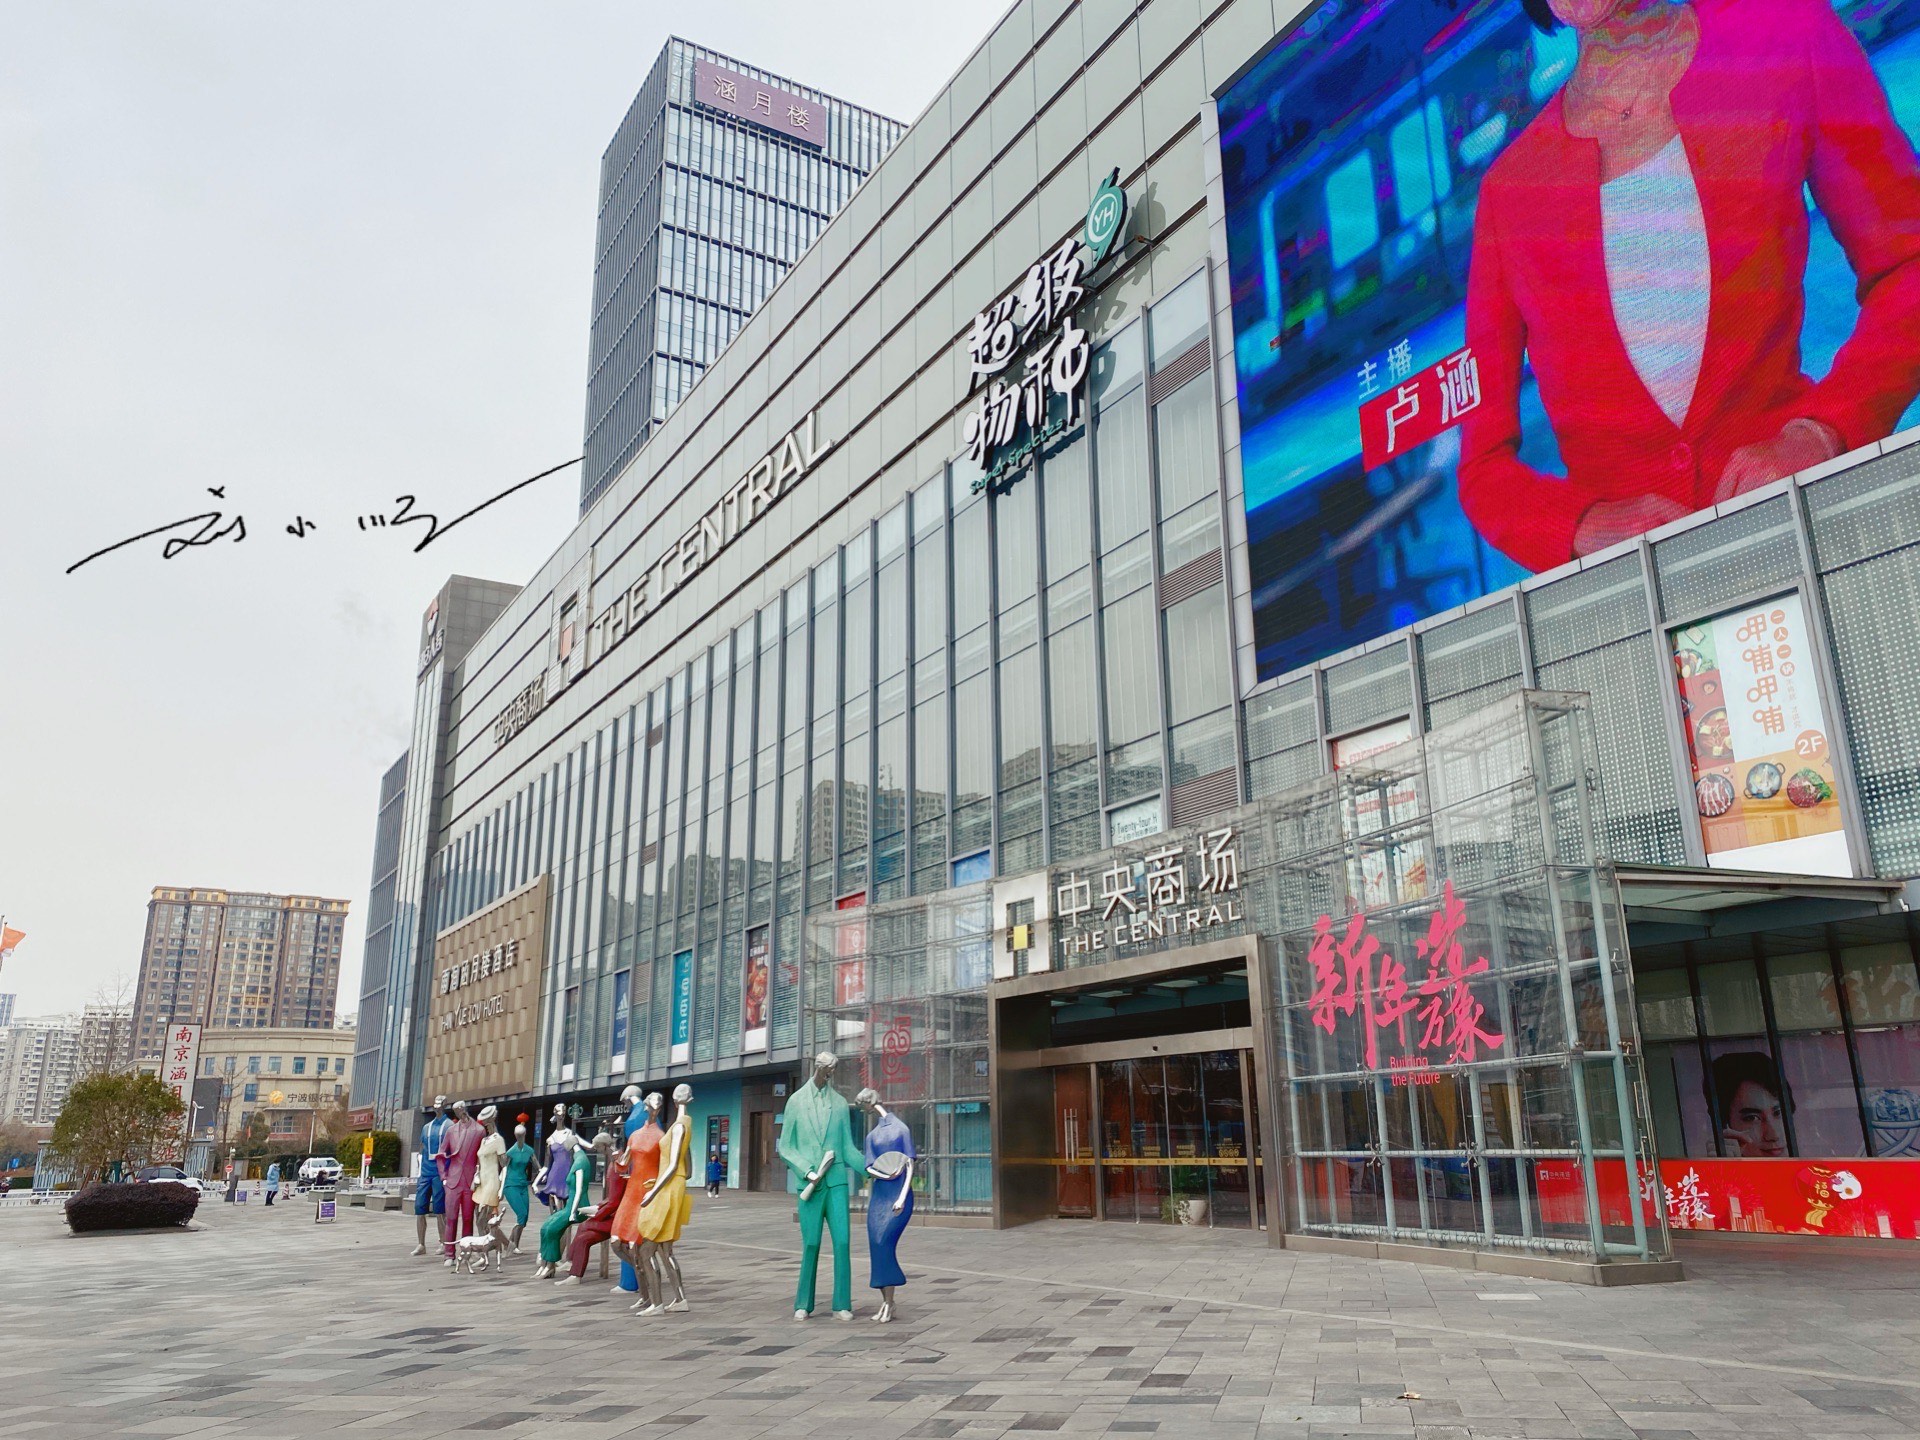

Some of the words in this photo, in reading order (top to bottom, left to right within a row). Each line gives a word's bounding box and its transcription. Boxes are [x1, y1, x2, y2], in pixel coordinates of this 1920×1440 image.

[714, 75, 810, 131] 涵月楼
[1095, 200, 1114, 234] YH
[967, 237, 1084, 397] 超级
[963, 315, 1089, 464] 物种
[1357, 338, 1412, 400] 主播
[1386, 347, 1482, 454] 卢涵
[969, 457, 1007, 494] Super
[1008, 418, 1065, 465] Species
[594, 572, 650, 655] THE
[658, 410, 838, 602] CENTRAL
[1736, 613, 1786, 736] 呷哺呷哺
[494, 673, 546, 748] 中央商场
[1797, 734, 1824, 756] 2F
[1057, 826, 1239, 928] 中央商场
[1059, 930, 1105, 956] THE
[1114, 901, 1243, 946] CENTRAL
[483, 994, 505, 1018] HOTEL
[1390, 1056, 1429, 1070] Building
[1391, 1071, 1407, 1086] the
[1409, 1069, 1441, 1086] Future
[287, 1092, 331, 1103] 宁波银行
[598, 1104, 623, 1115] STARBUCKS
[1814, 1180, 1830, 1199] 福
